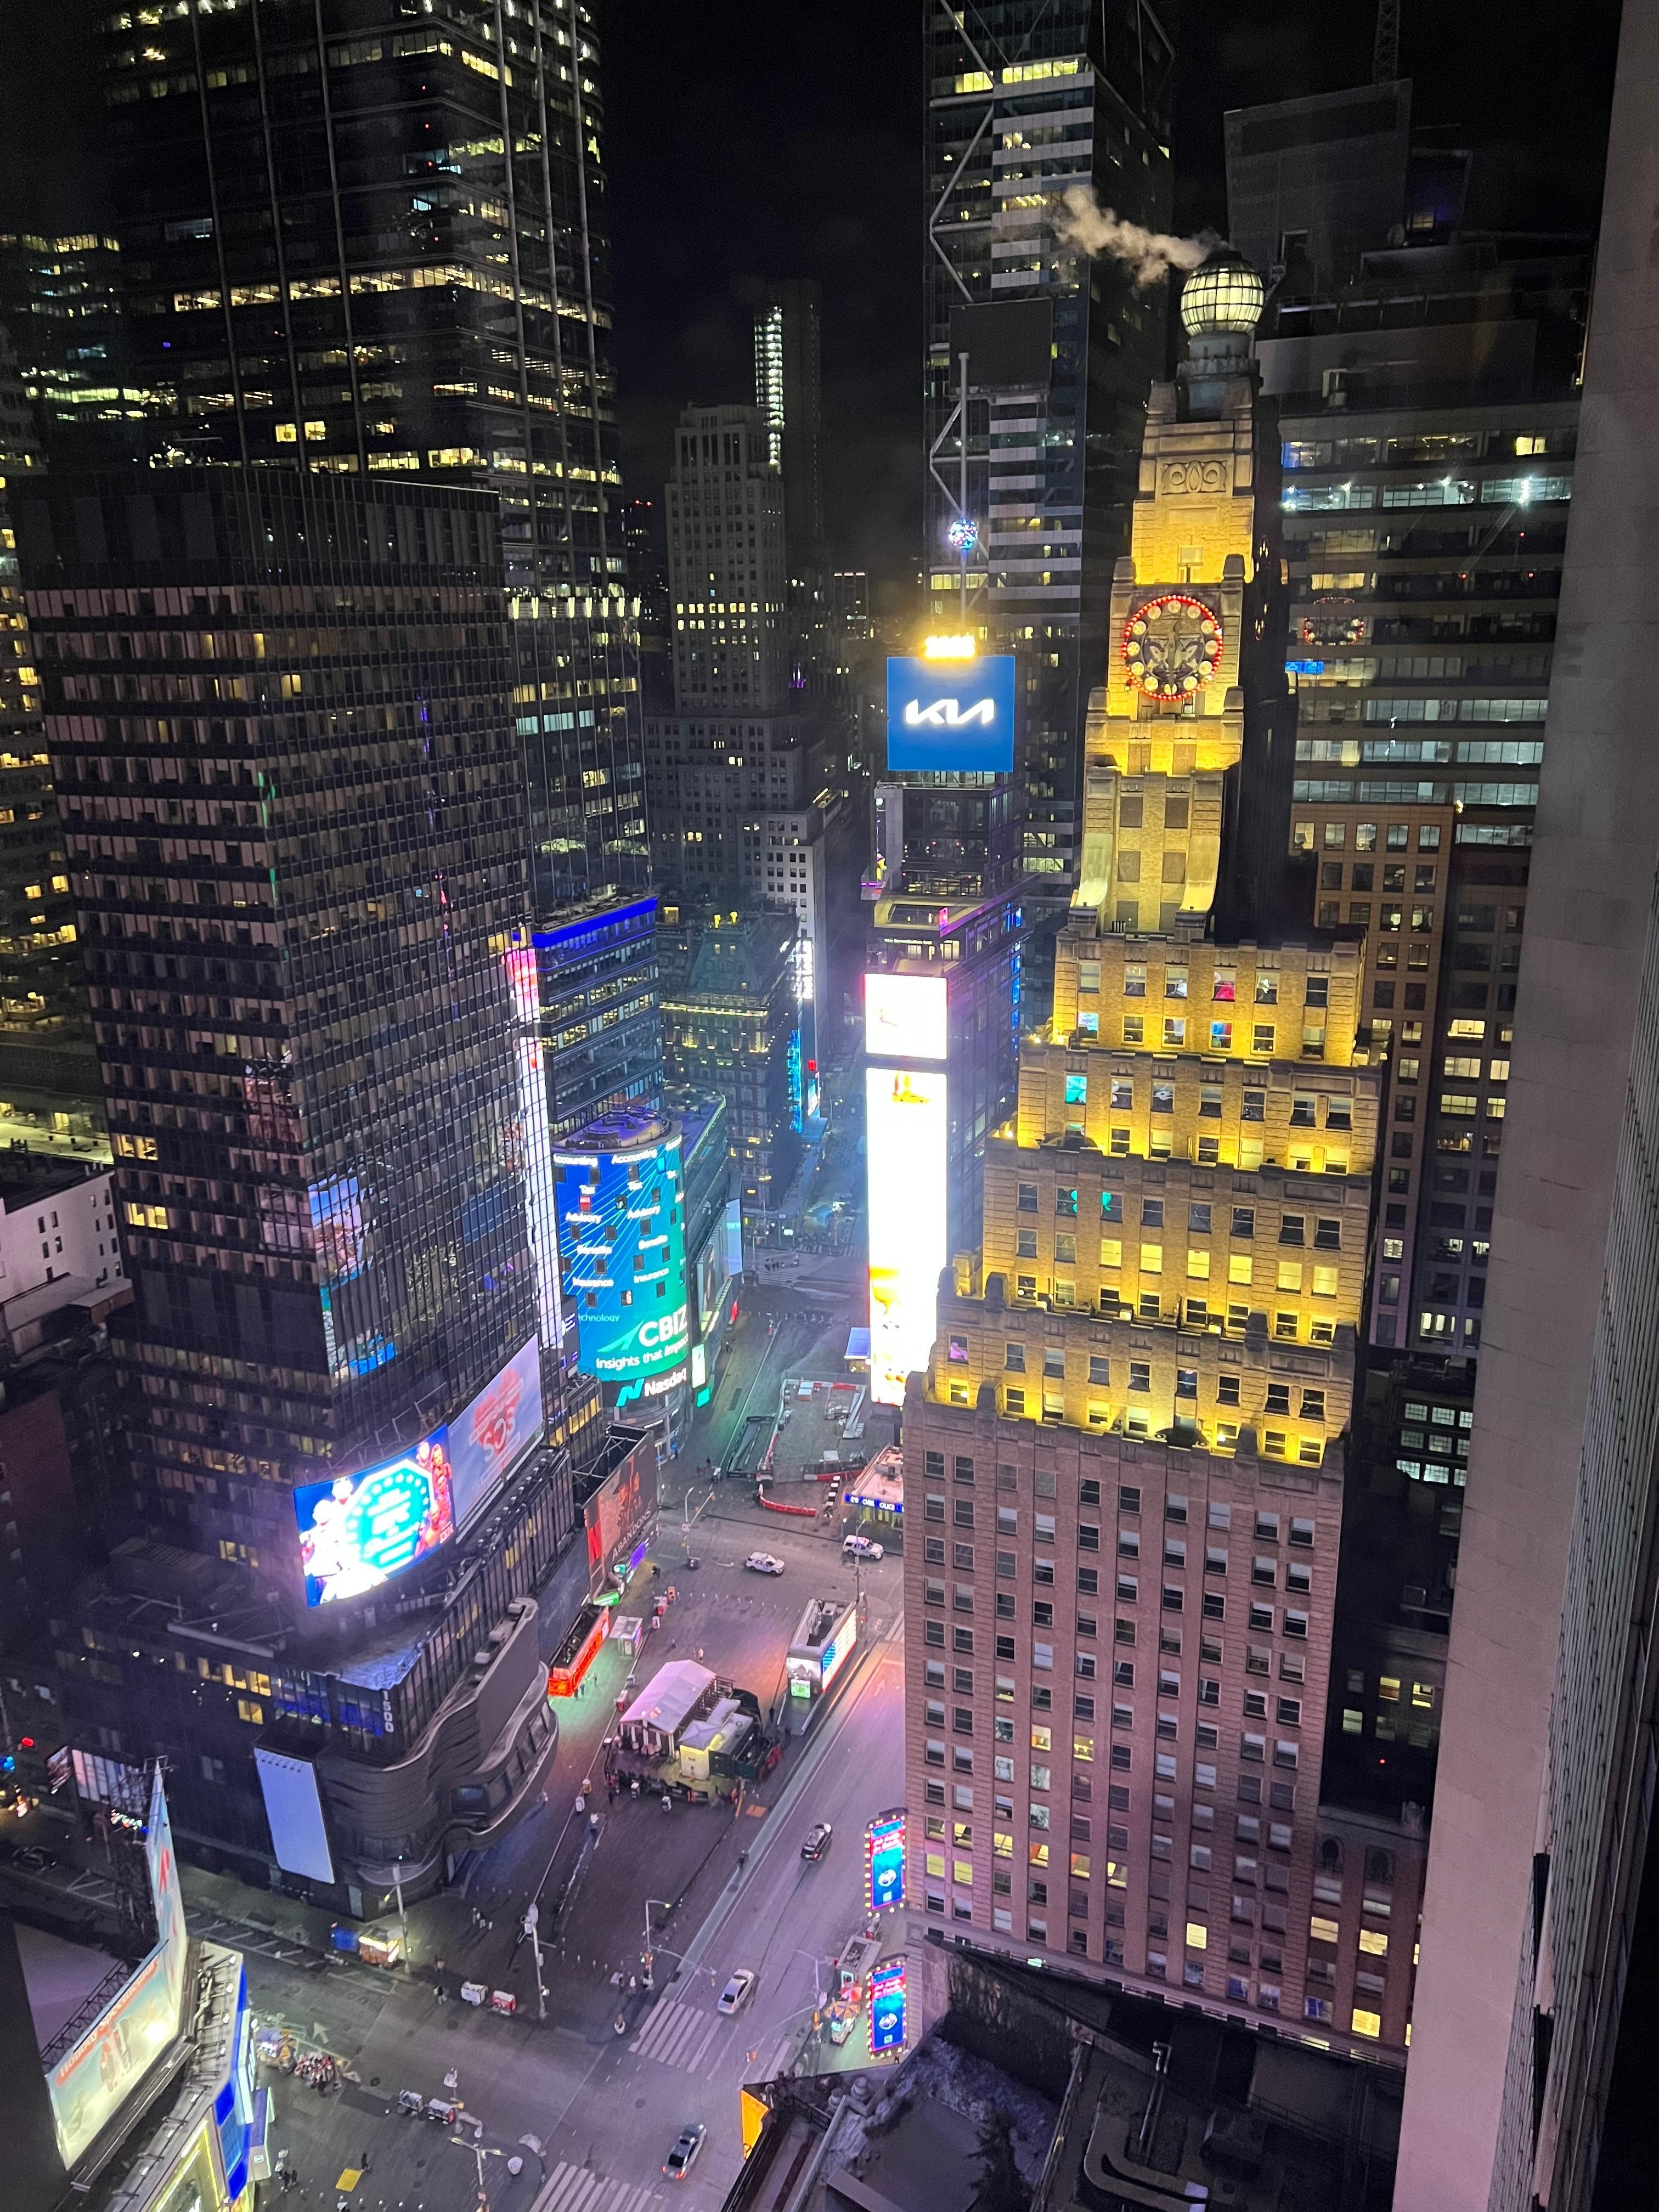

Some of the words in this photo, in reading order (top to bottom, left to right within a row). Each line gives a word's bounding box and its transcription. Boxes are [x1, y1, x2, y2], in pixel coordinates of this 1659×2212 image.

[612, 1149, 657, 1164] Accounting
[579, 1185, 596, 1194] Tax
[565, 1212, 602, 1224] Advisory
[628, 1205, 661, 1220] Advisory
[572, 1277, 614, 1288] Insurance
[634, 1267, 669, 1283] Insurance
[578, 1313, 620, 1323] echnology
[638, 1304, 688, 1347] CBIZ
[596, 1357, 640, 1370] Insights
[642, 1348, 663, 1363] that
[644, 1368, 687, 1397] Nasdaq
[612, 1509, 651, 1562] ABANDONS
[383, 1690, 394, 1733] 1500
